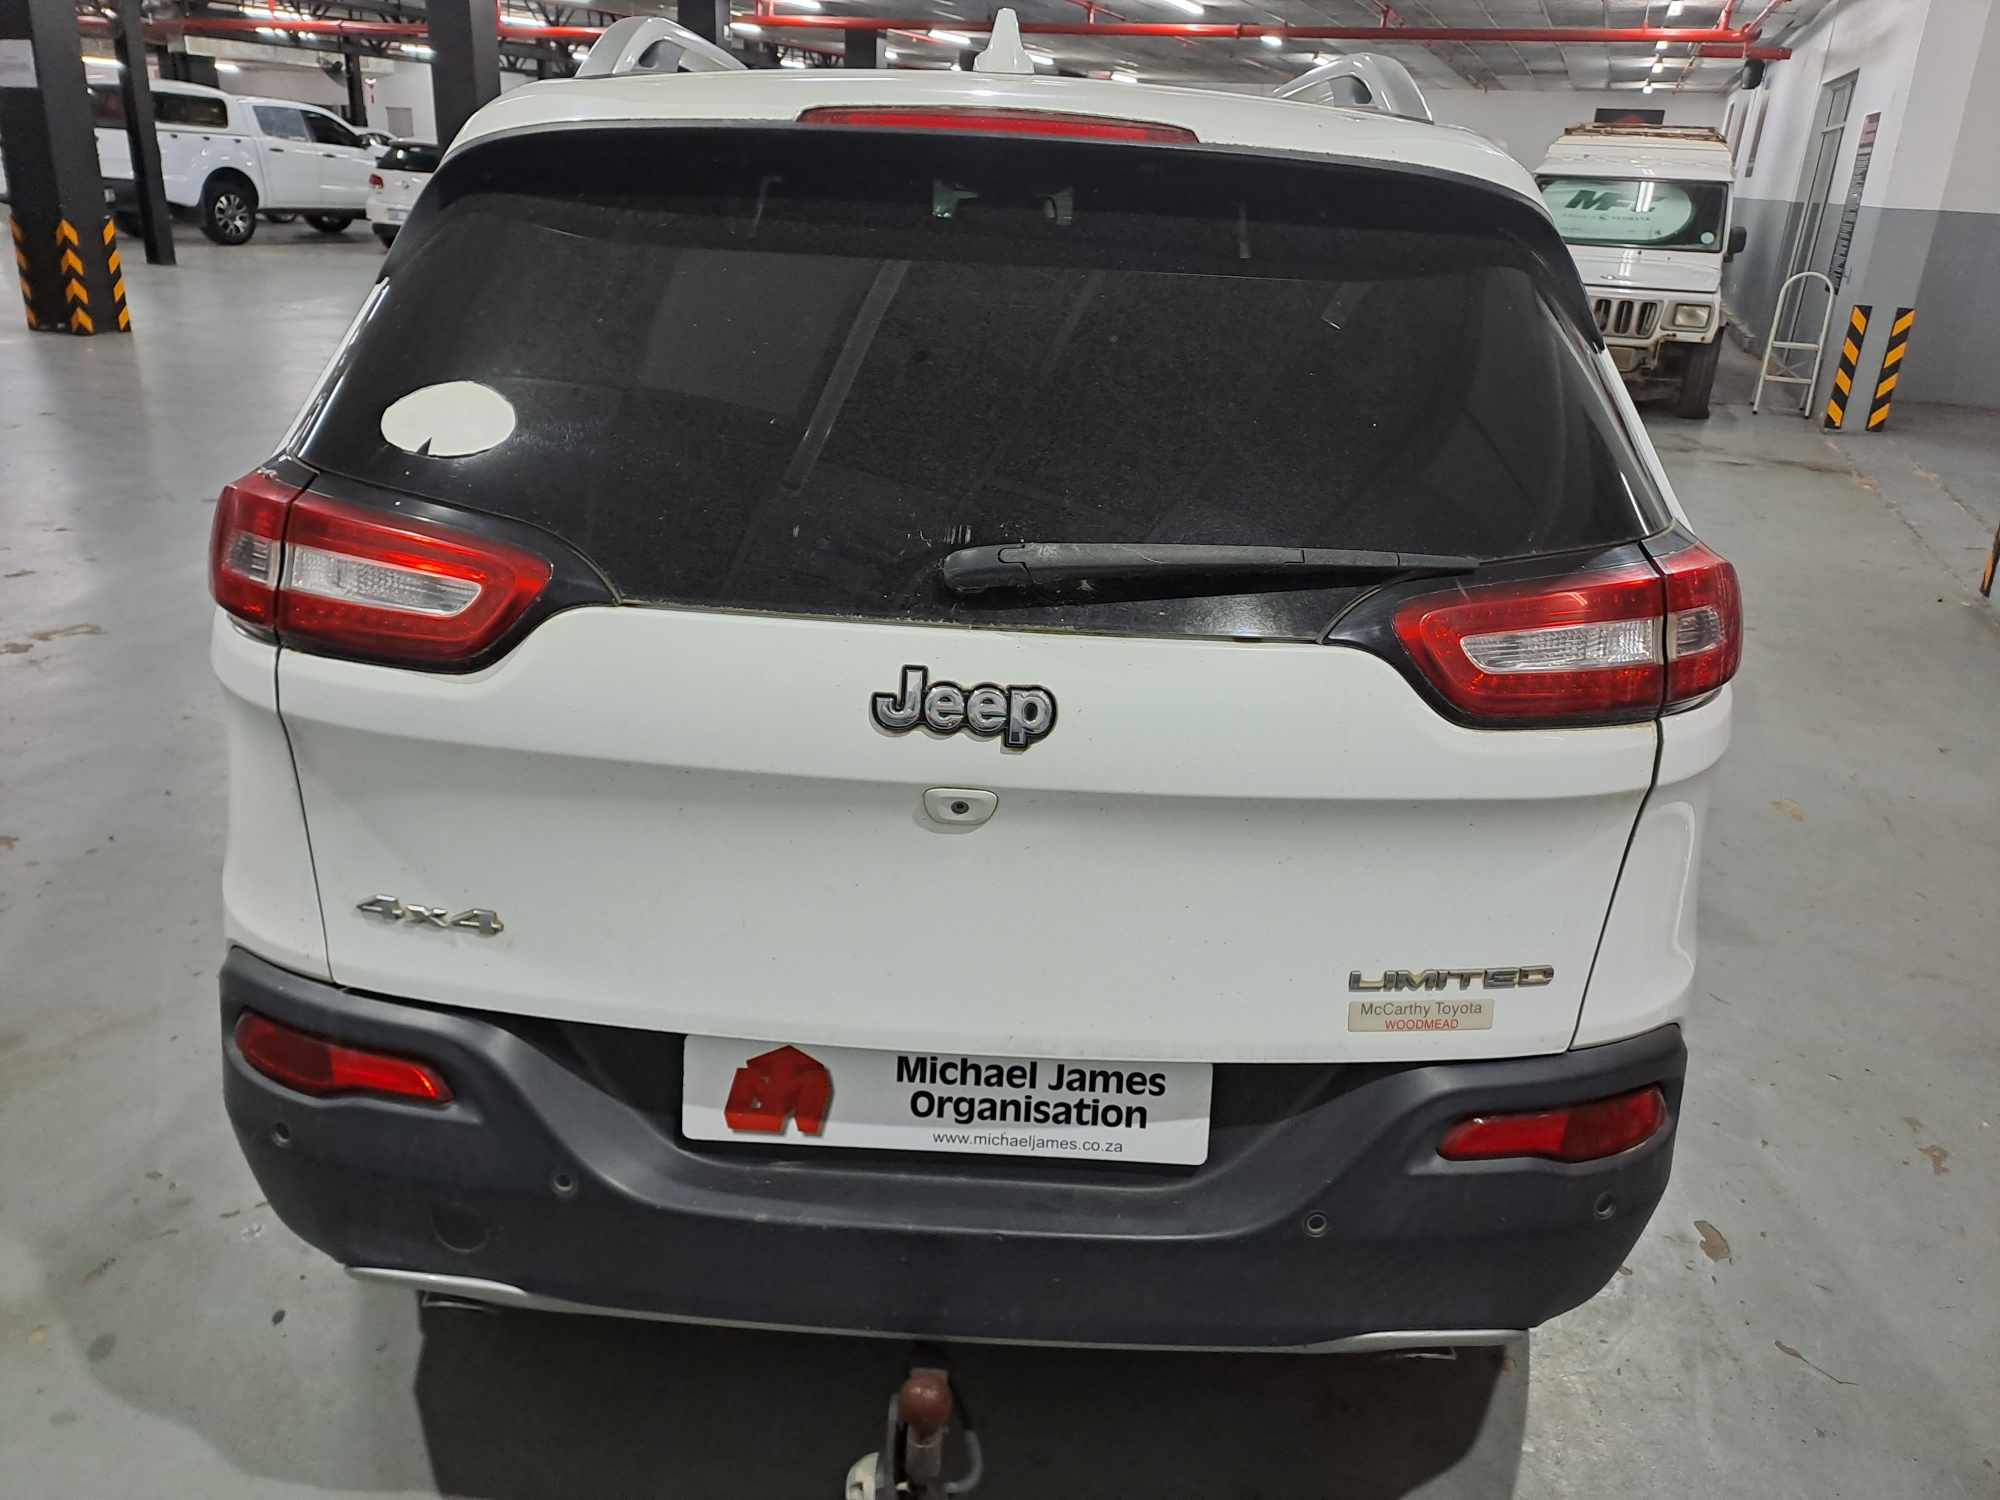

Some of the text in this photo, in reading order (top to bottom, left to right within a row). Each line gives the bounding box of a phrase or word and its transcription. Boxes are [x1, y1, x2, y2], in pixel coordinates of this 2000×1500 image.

[871, 664, 1057, 748] Jeep
[1349, 965, 1554, 992] LIMITED
[1360, 1001, 1482, 1018] McCarthy Toyota
[1384, 1018, 1459, 1031] WOODMEAD
[896, 1055, 1166, 1096] Michael James
[910, 1090, 1147, 1129] Organisation
[933, 1131, 1123, 1153] www.michaeljames.co.za
